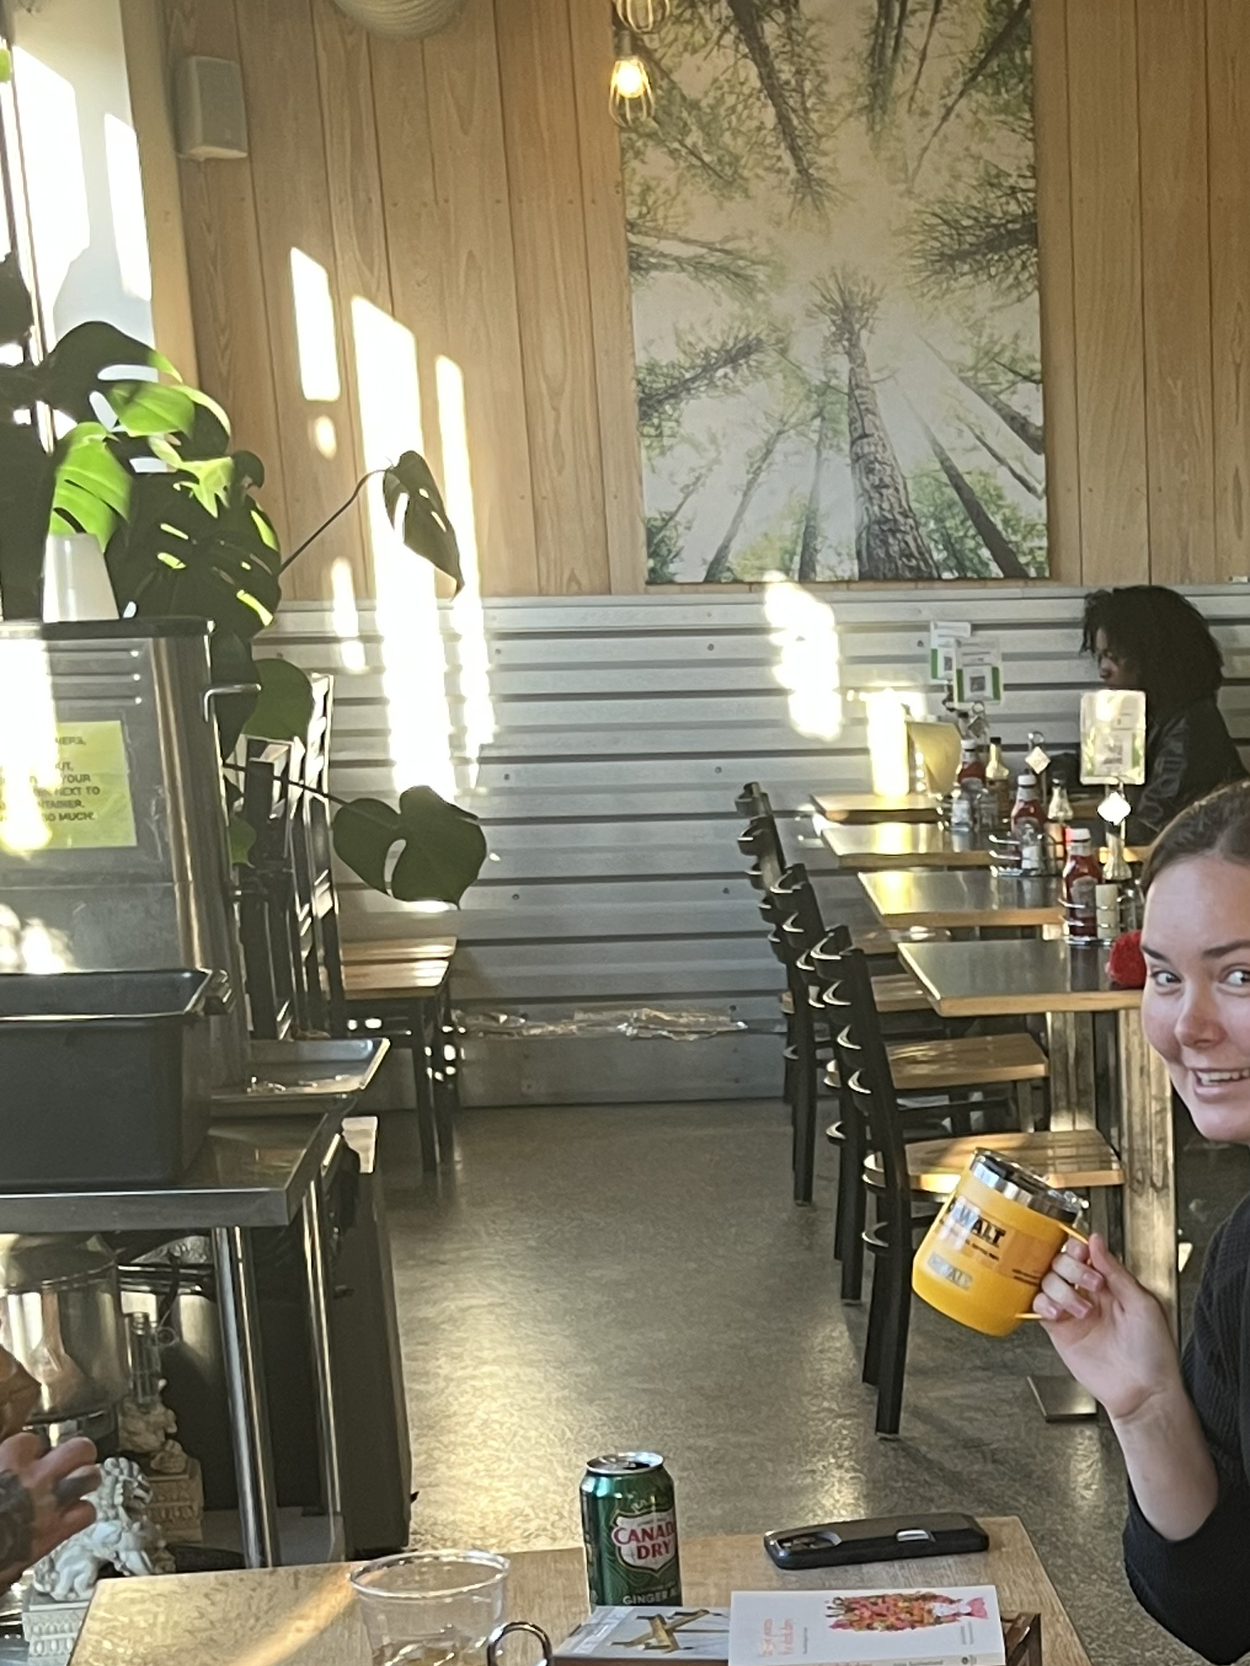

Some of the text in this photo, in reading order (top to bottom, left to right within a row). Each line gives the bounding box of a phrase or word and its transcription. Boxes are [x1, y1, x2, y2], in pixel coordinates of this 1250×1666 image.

[613, 1521, 676, 1545] CANAD
[636, 1539, 673, 1560] DRY
[622, 1589, 669, 1605] GINGER
